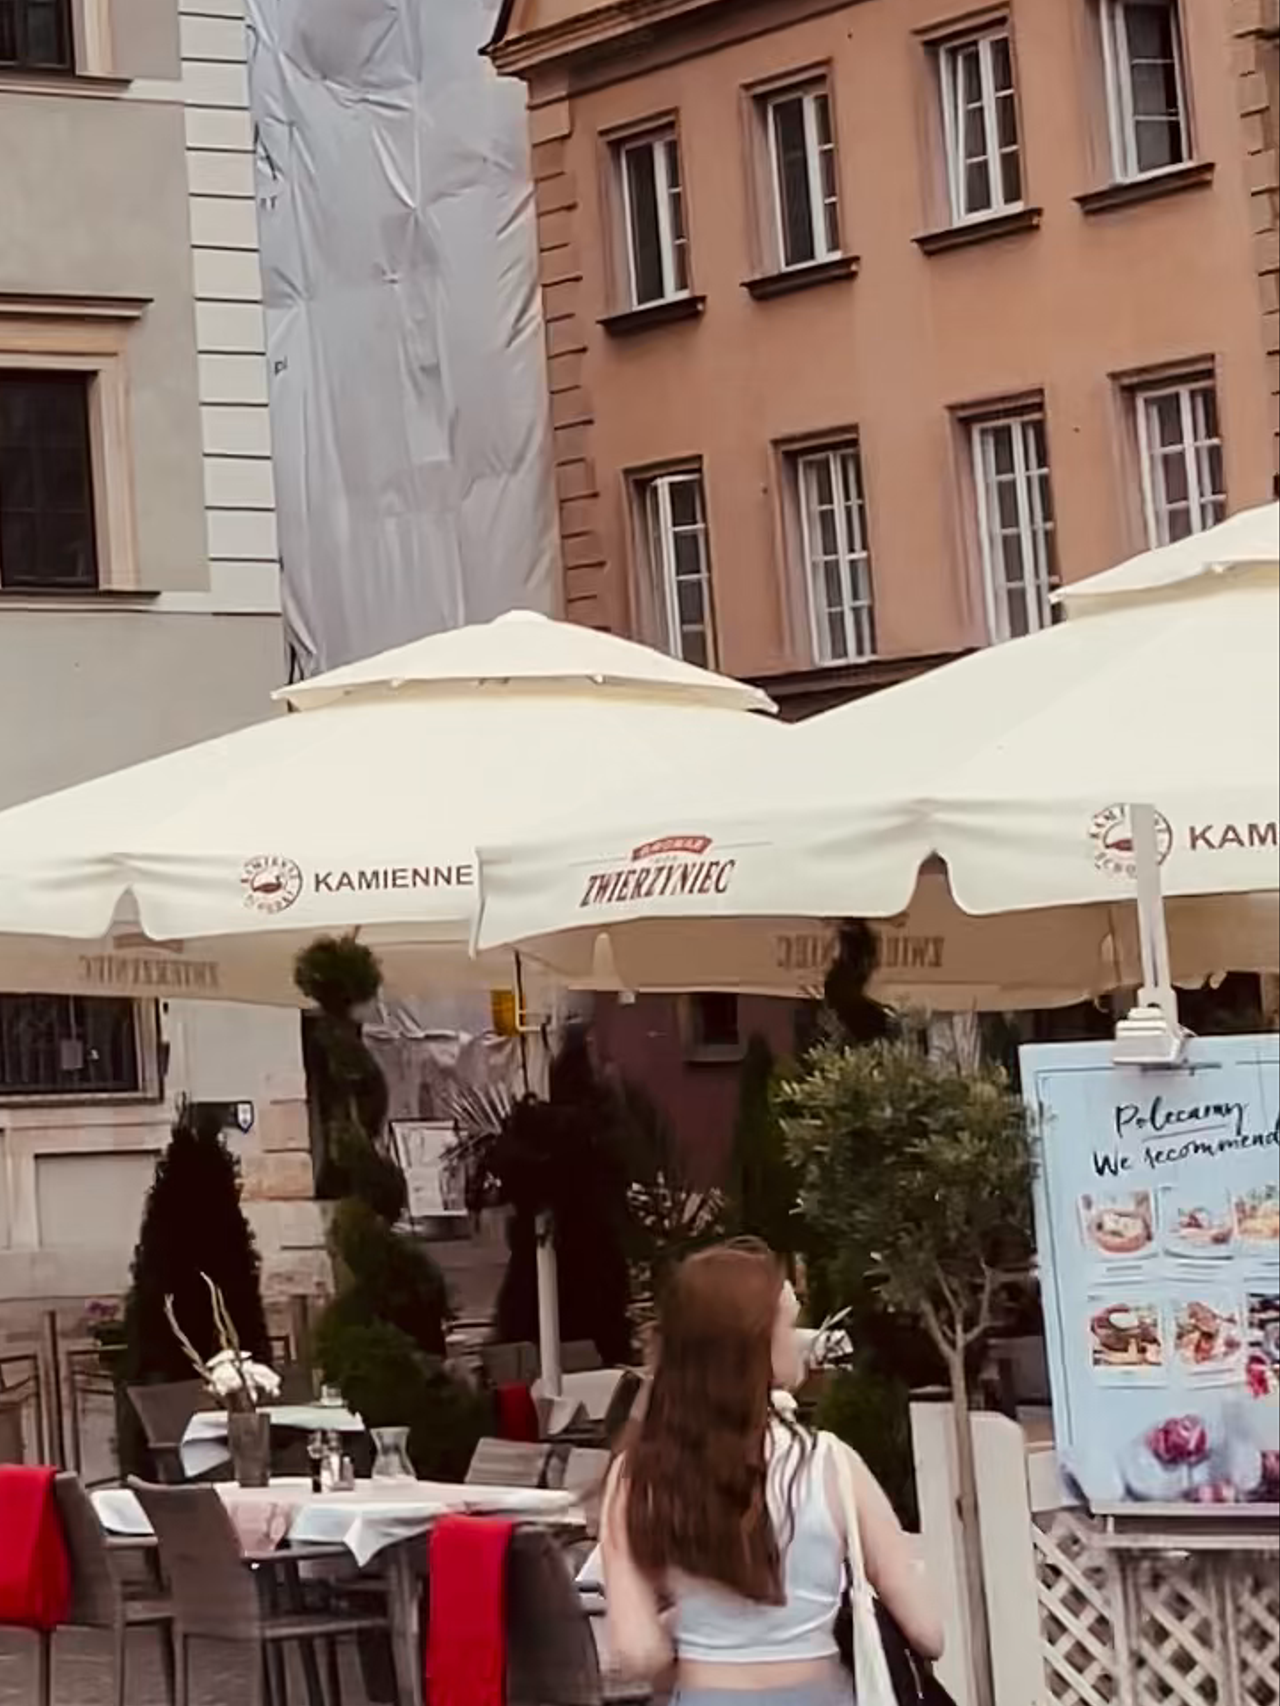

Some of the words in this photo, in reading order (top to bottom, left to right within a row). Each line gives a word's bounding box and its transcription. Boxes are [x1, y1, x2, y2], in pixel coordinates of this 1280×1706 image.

[314, 864, 474, 892] KAMIENNE
[579, 859, 735, 908] ZWIERZYNIEC
[1093, 1144, 1132, 1177] We
